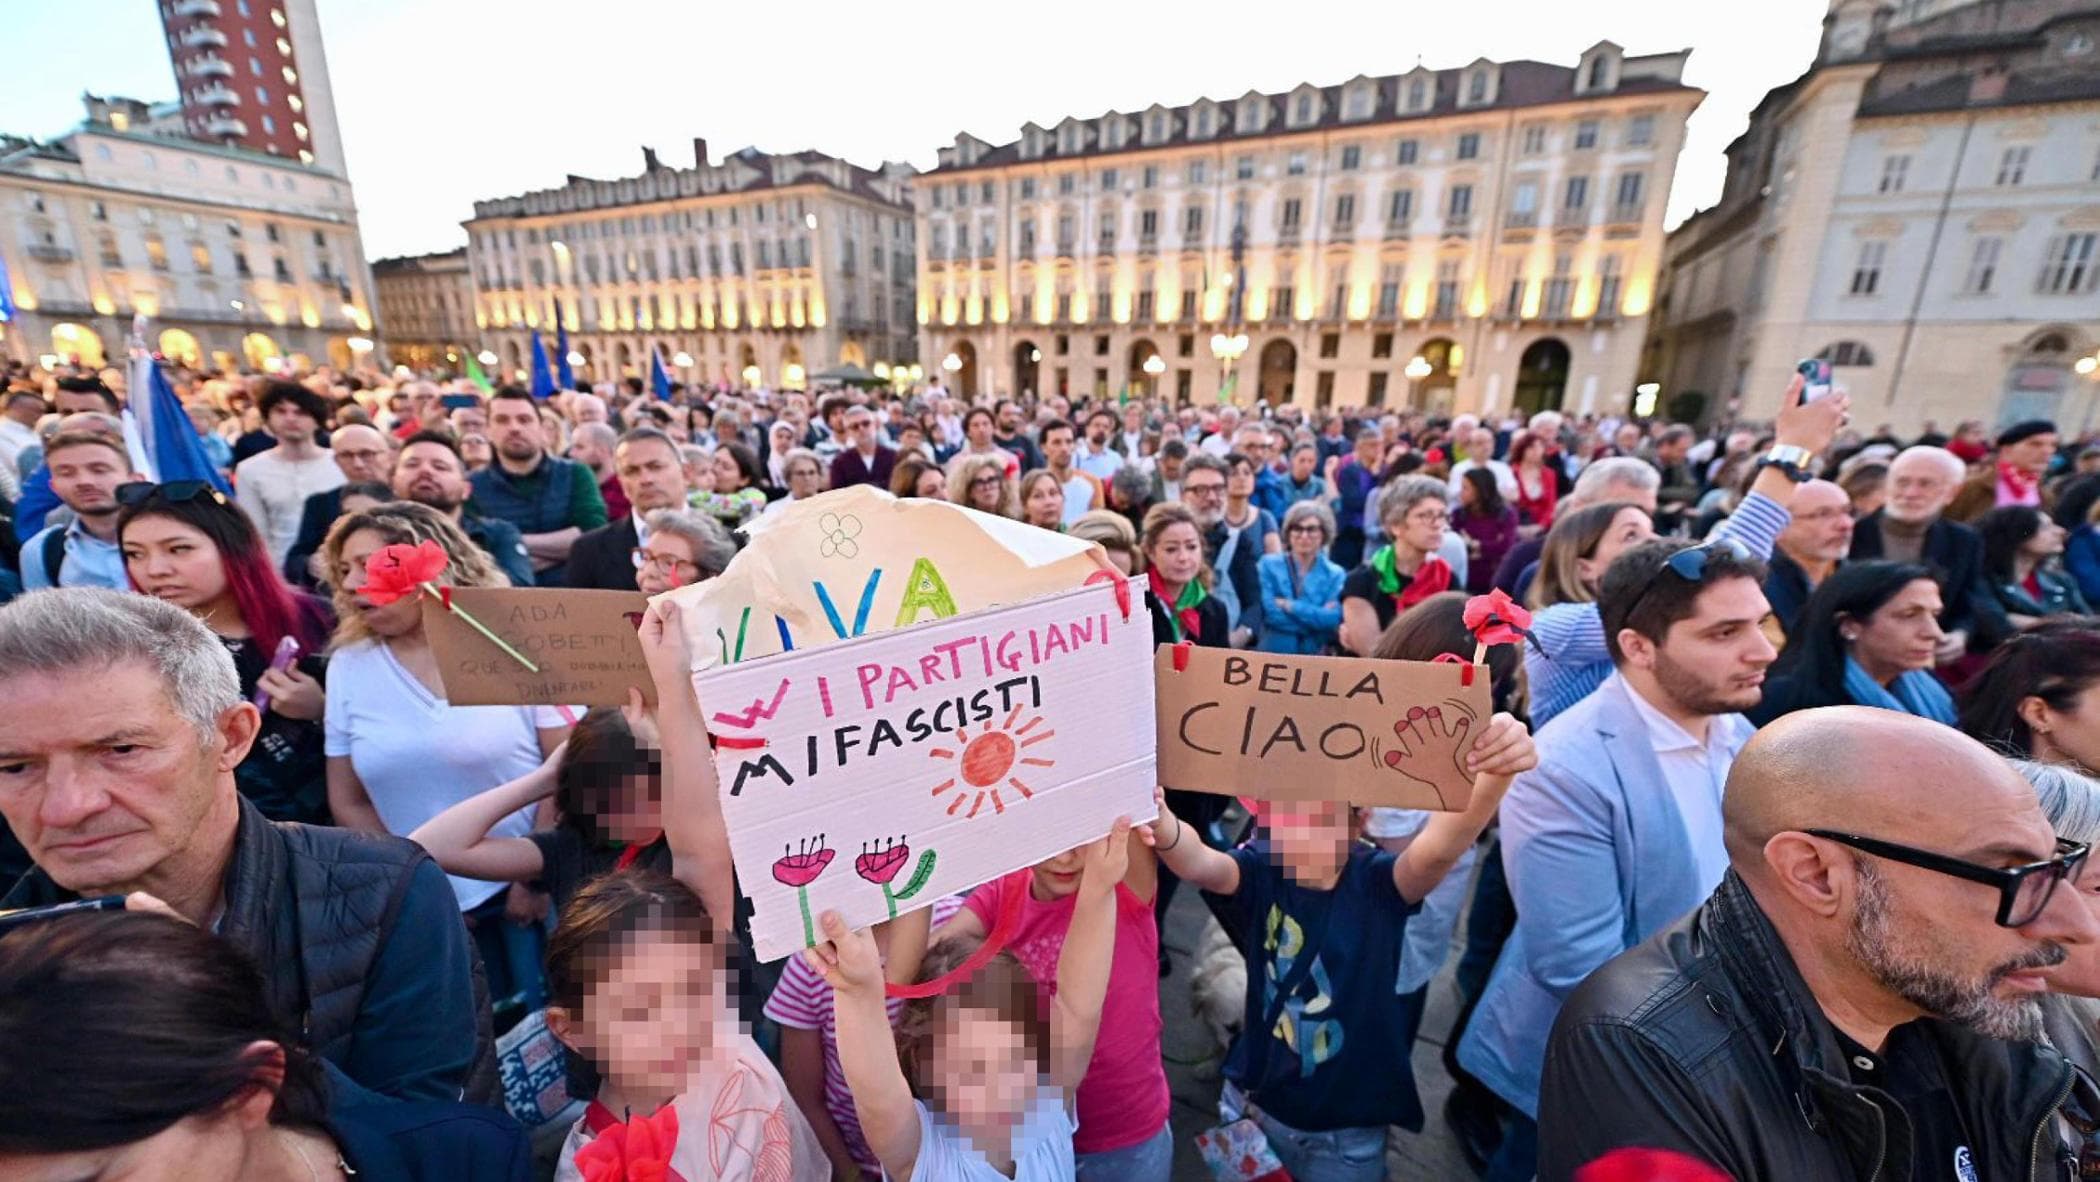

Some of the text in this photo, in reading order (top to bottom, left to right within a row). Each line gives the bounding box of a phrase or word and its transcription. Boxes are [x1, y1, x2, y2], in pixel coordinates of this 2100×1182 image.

[509, 602, 568, 624] ADA
[717, 557, 957, 664] VIVA
[712, 614, 1109, 729] W I PARTIGIANI
[1223, 656, 1385, 705] BELLA
[834, 675, 1042, 767] FASCISTI
[1178, 701, 1366, 760] CIAO
